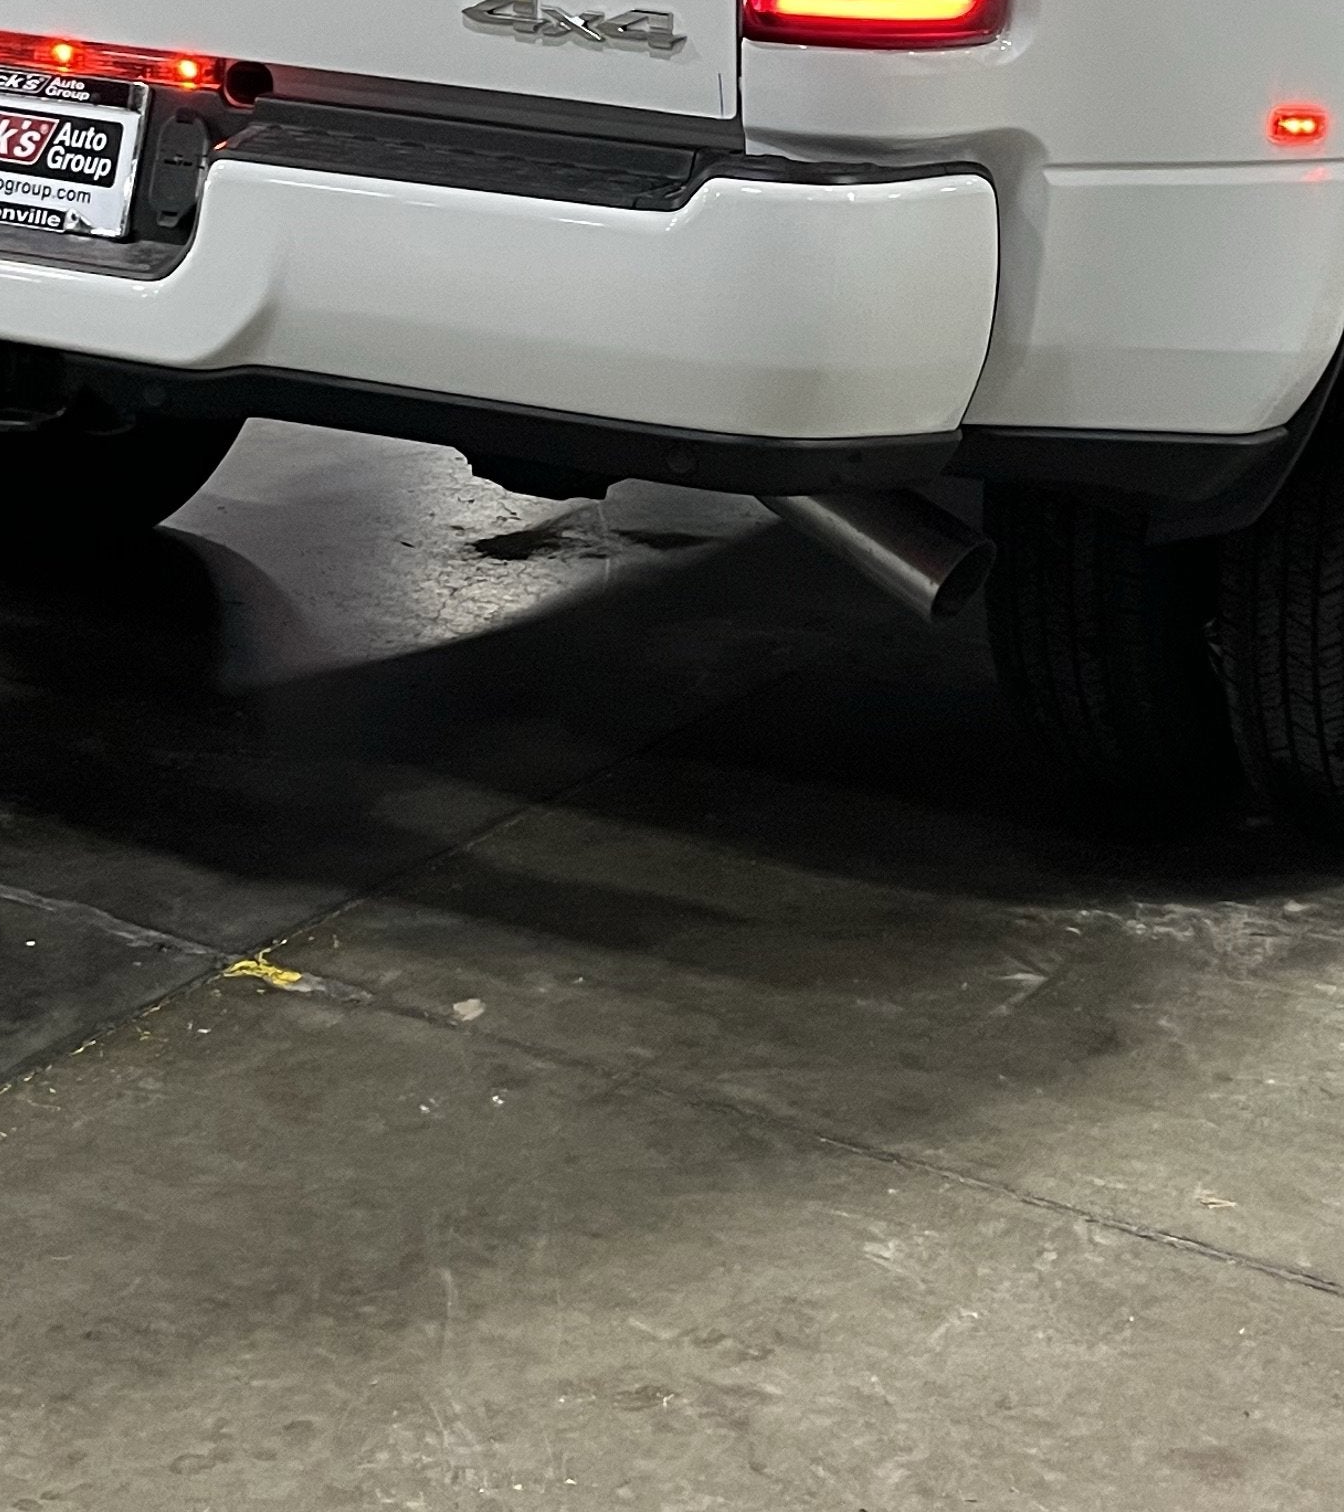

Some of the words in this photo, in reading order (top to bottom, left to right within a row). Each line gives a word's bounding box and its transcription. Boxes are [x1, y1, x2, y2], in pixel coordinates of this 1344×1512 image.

[44, 86, 91, 101] Group
[50, 77, 86, 91] Auto
[53, 121, 108, 151] Auto
[46, 145, 113, 180] Group
